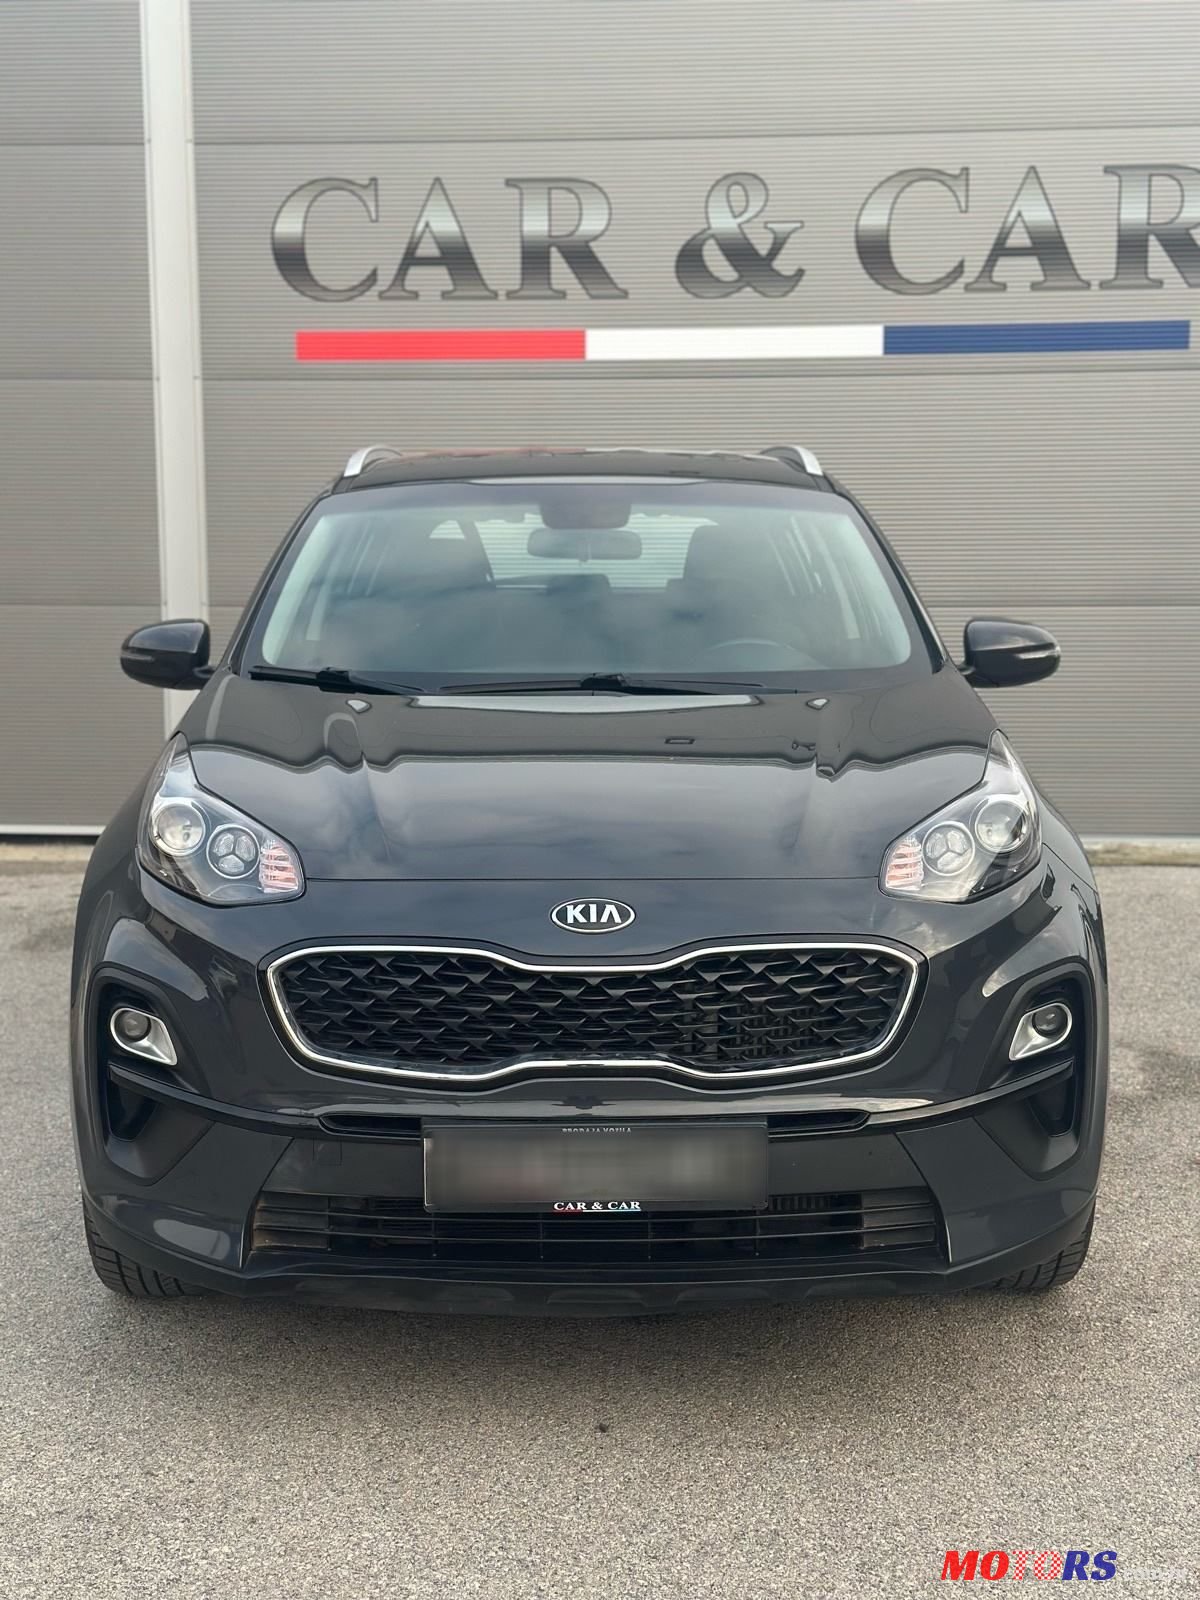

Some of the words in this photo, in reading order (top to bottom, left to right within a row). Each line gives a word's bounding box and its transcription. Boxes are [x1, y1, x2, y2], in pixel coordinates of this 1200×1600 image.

[270, 176, 628, 302] CAR
[675, 171, 805, 299] &
[854, 163, 1200, 296] CAR
[566, 903, 622, 924] KIA
[553, 1202, 587, 1211] CAR
[591, 1201, 604, 1211] &
[607, 1201, 641, 1210] CAR
